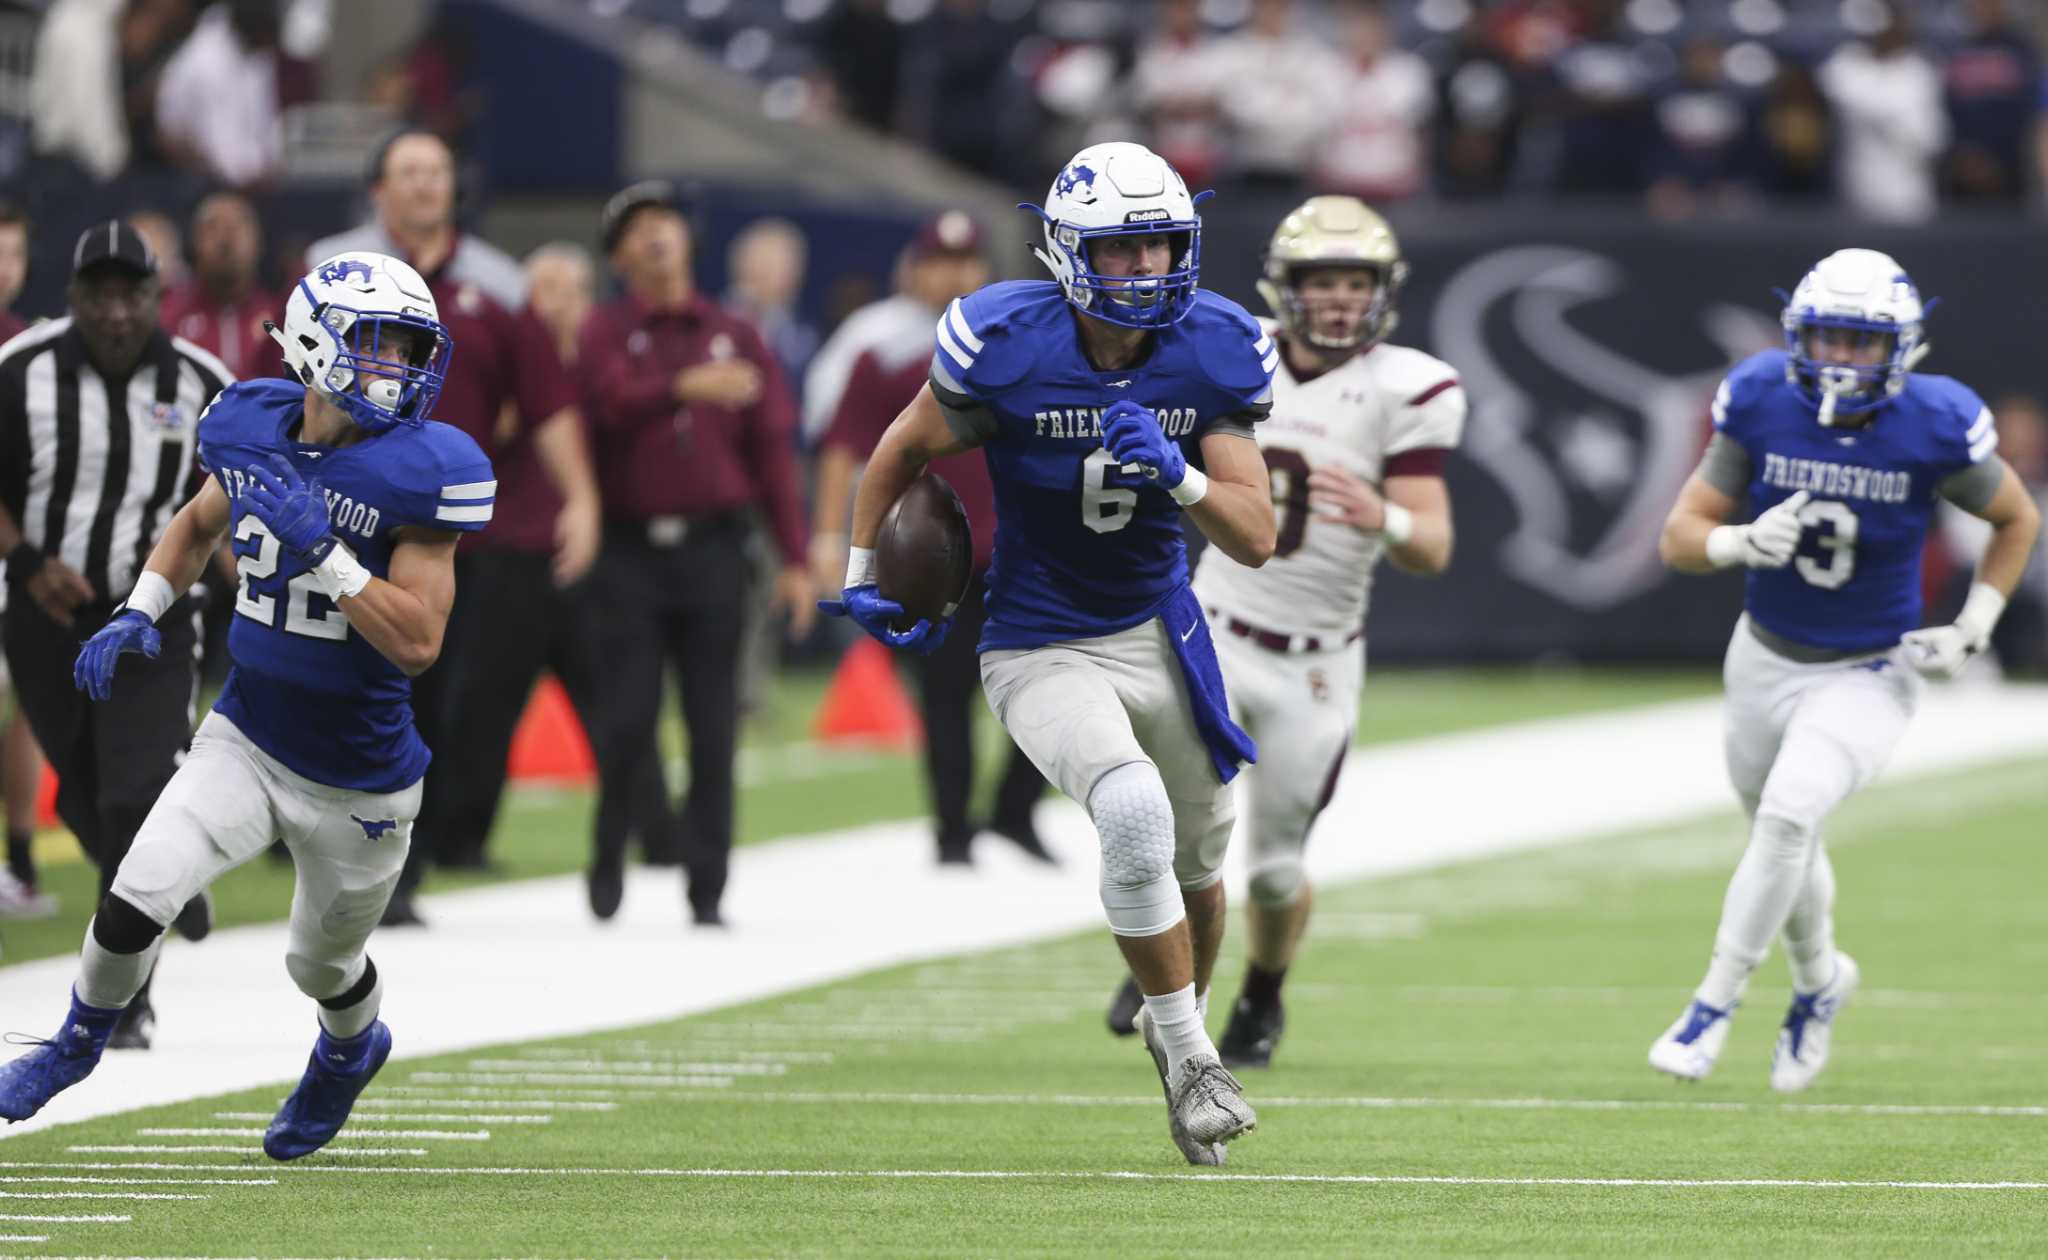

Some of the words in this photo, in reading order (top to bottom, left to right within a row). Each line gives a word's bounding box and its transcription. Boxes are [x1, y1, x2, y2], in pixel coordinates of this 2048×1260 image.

[1035, 408, 1197, 438] FRIENOOD
[1082, 447, 1141, 534] 6
[1763, 453, 1911, 503] FRIENDSWOOD
[235, 514, 348, 641] 22
[1796, 500, 1860, 590] 3
